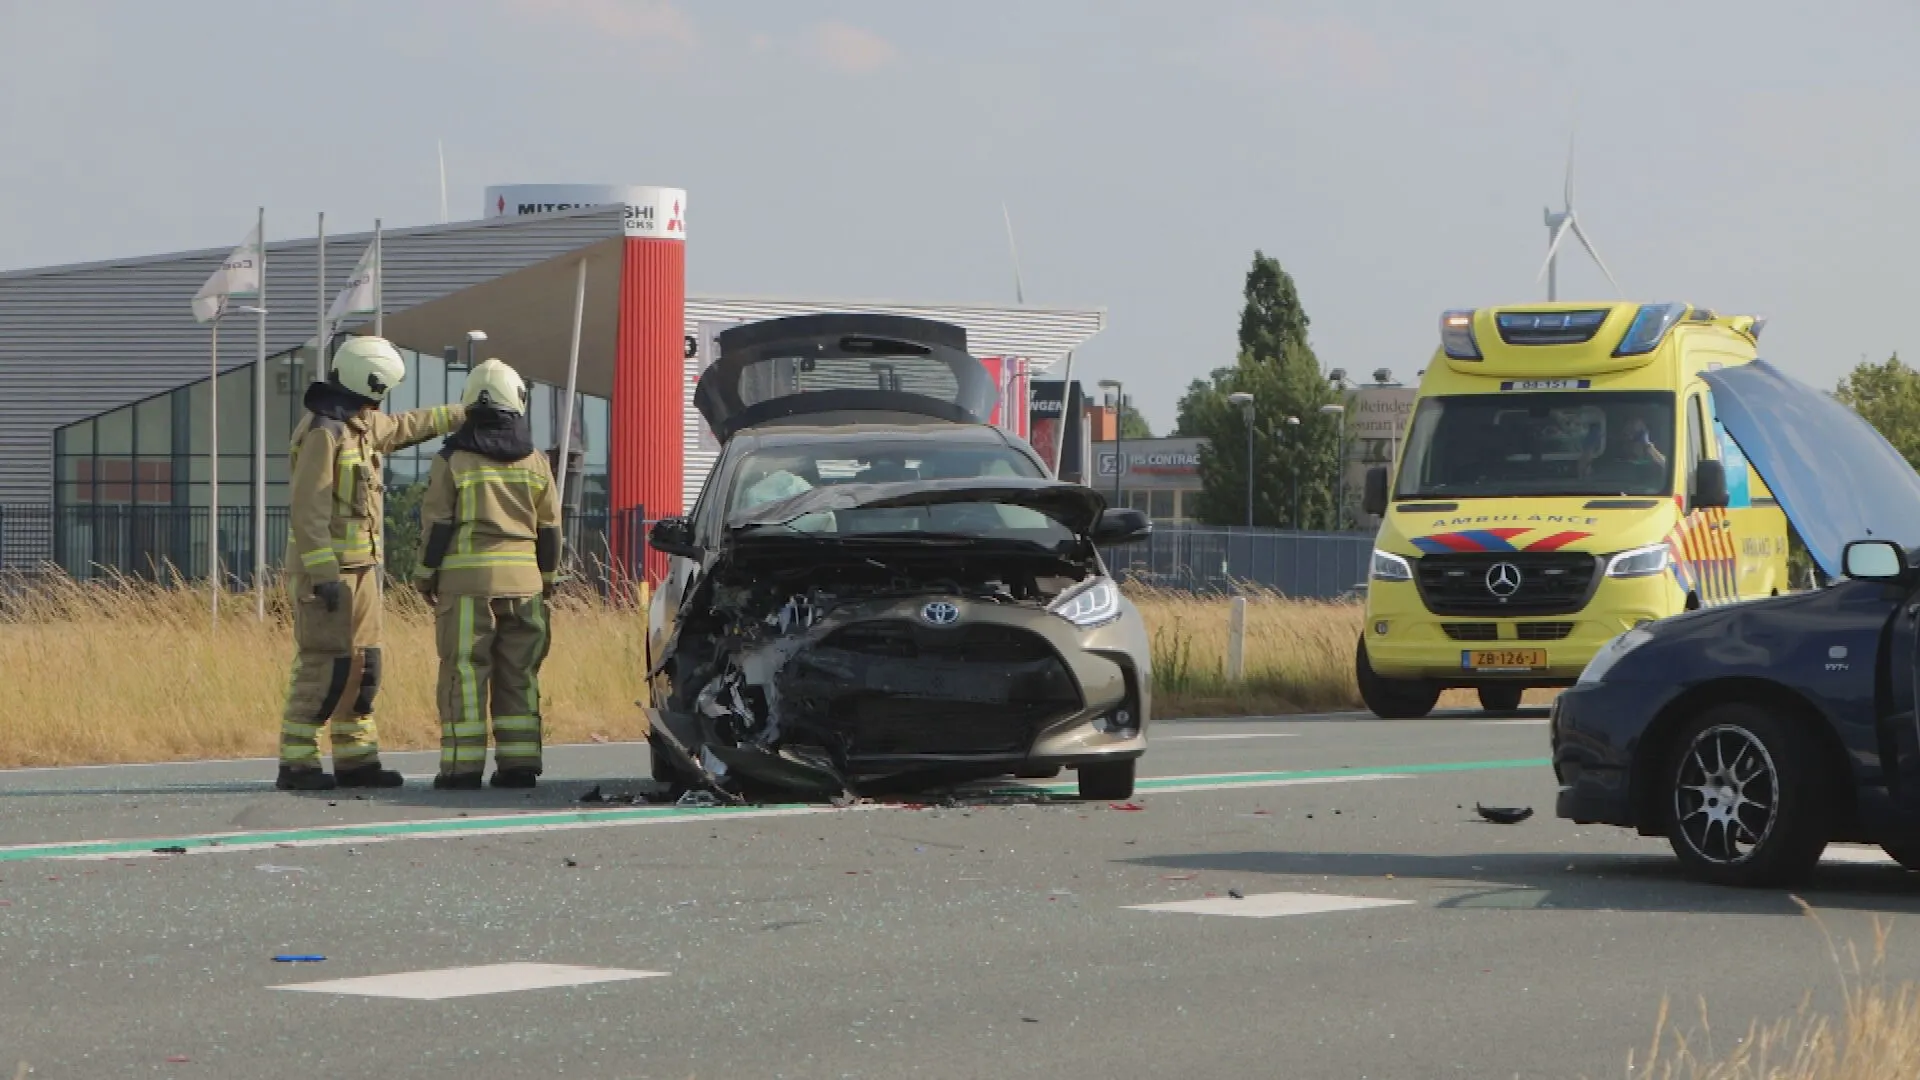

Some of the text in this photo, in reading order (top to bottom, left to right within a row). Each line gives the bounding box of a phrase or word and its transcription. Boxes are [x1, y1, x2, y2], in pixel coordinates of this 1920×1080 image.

[1148, 454, 1200, 465] CONTRAC
[1433, 515, 1597, 528] AMBULANCE
[1477, 651, 1537, 665] ZB-126-J
